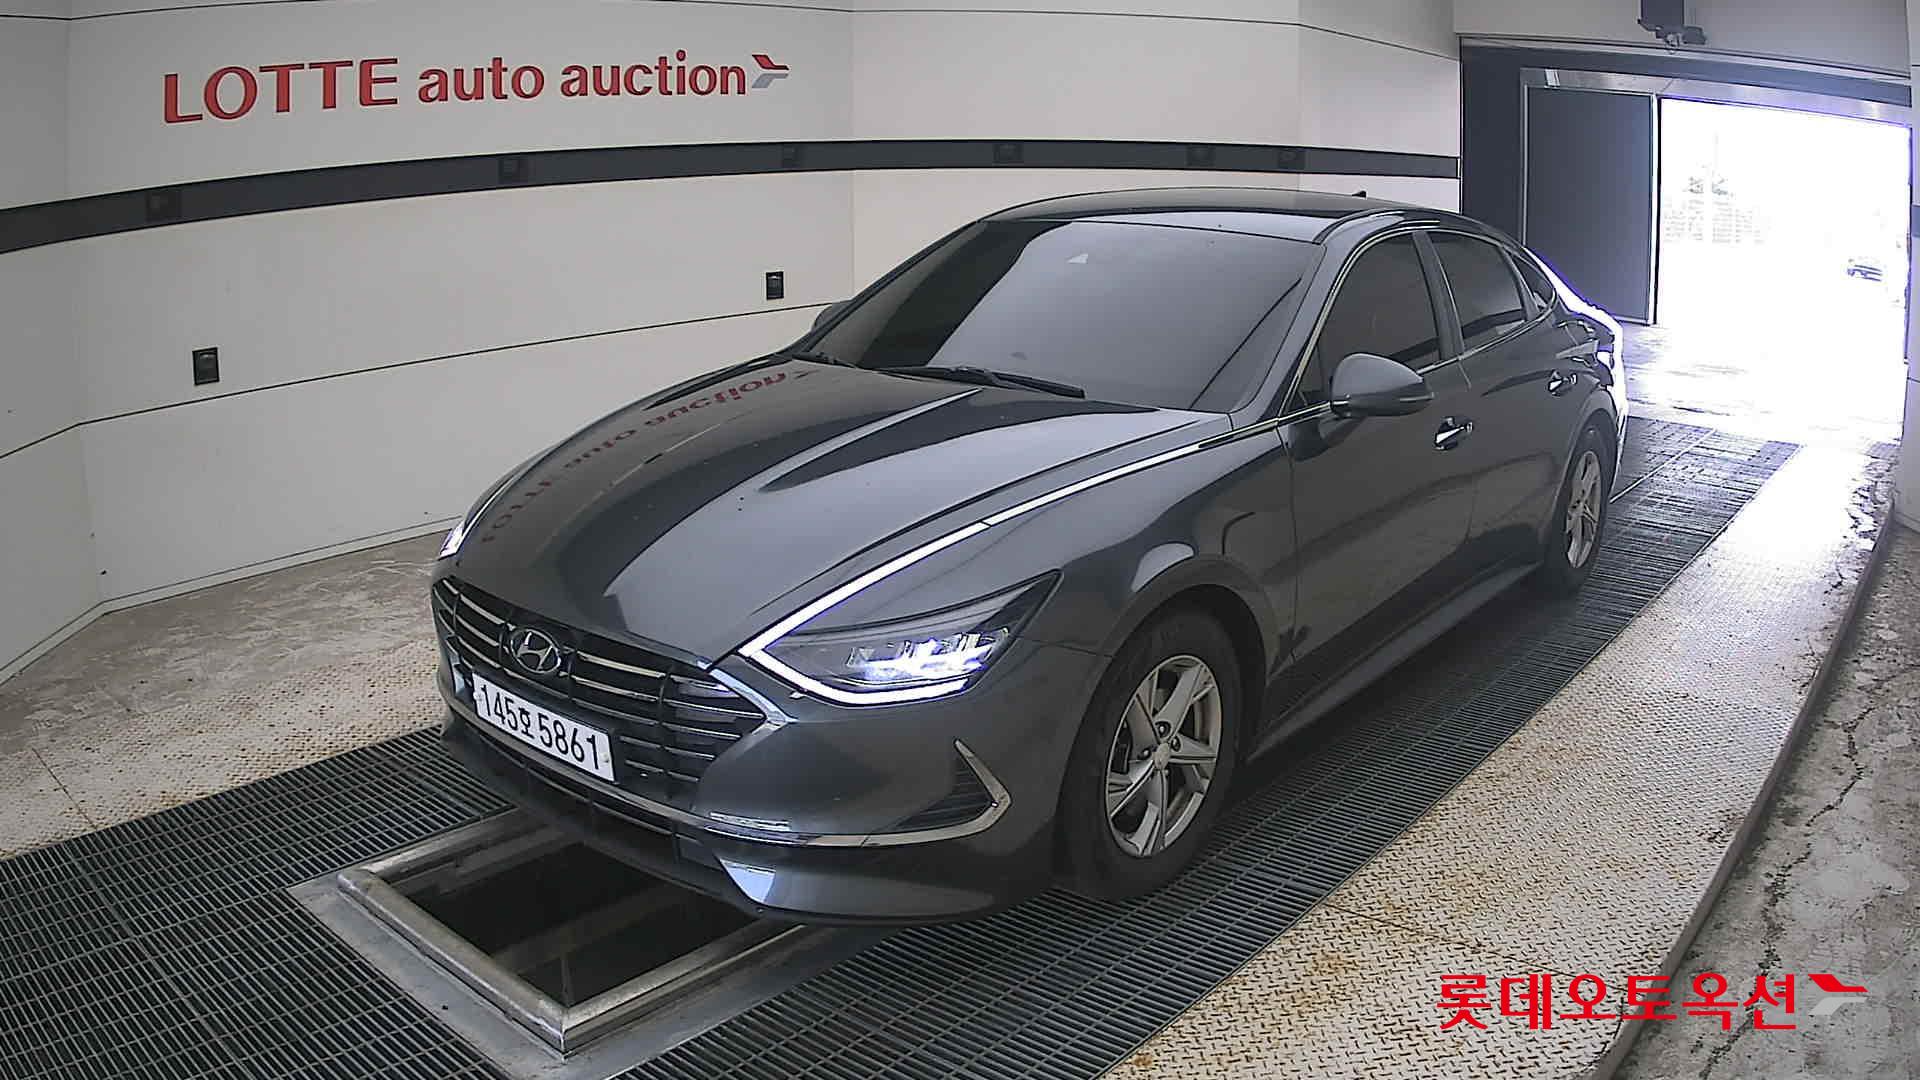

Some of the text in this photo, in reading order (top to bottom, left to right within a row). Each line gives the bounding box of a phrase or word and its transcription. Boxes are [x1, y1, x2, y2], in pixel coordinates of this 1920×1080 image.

[164, 50, 747, 123] LOTTE auto auction
